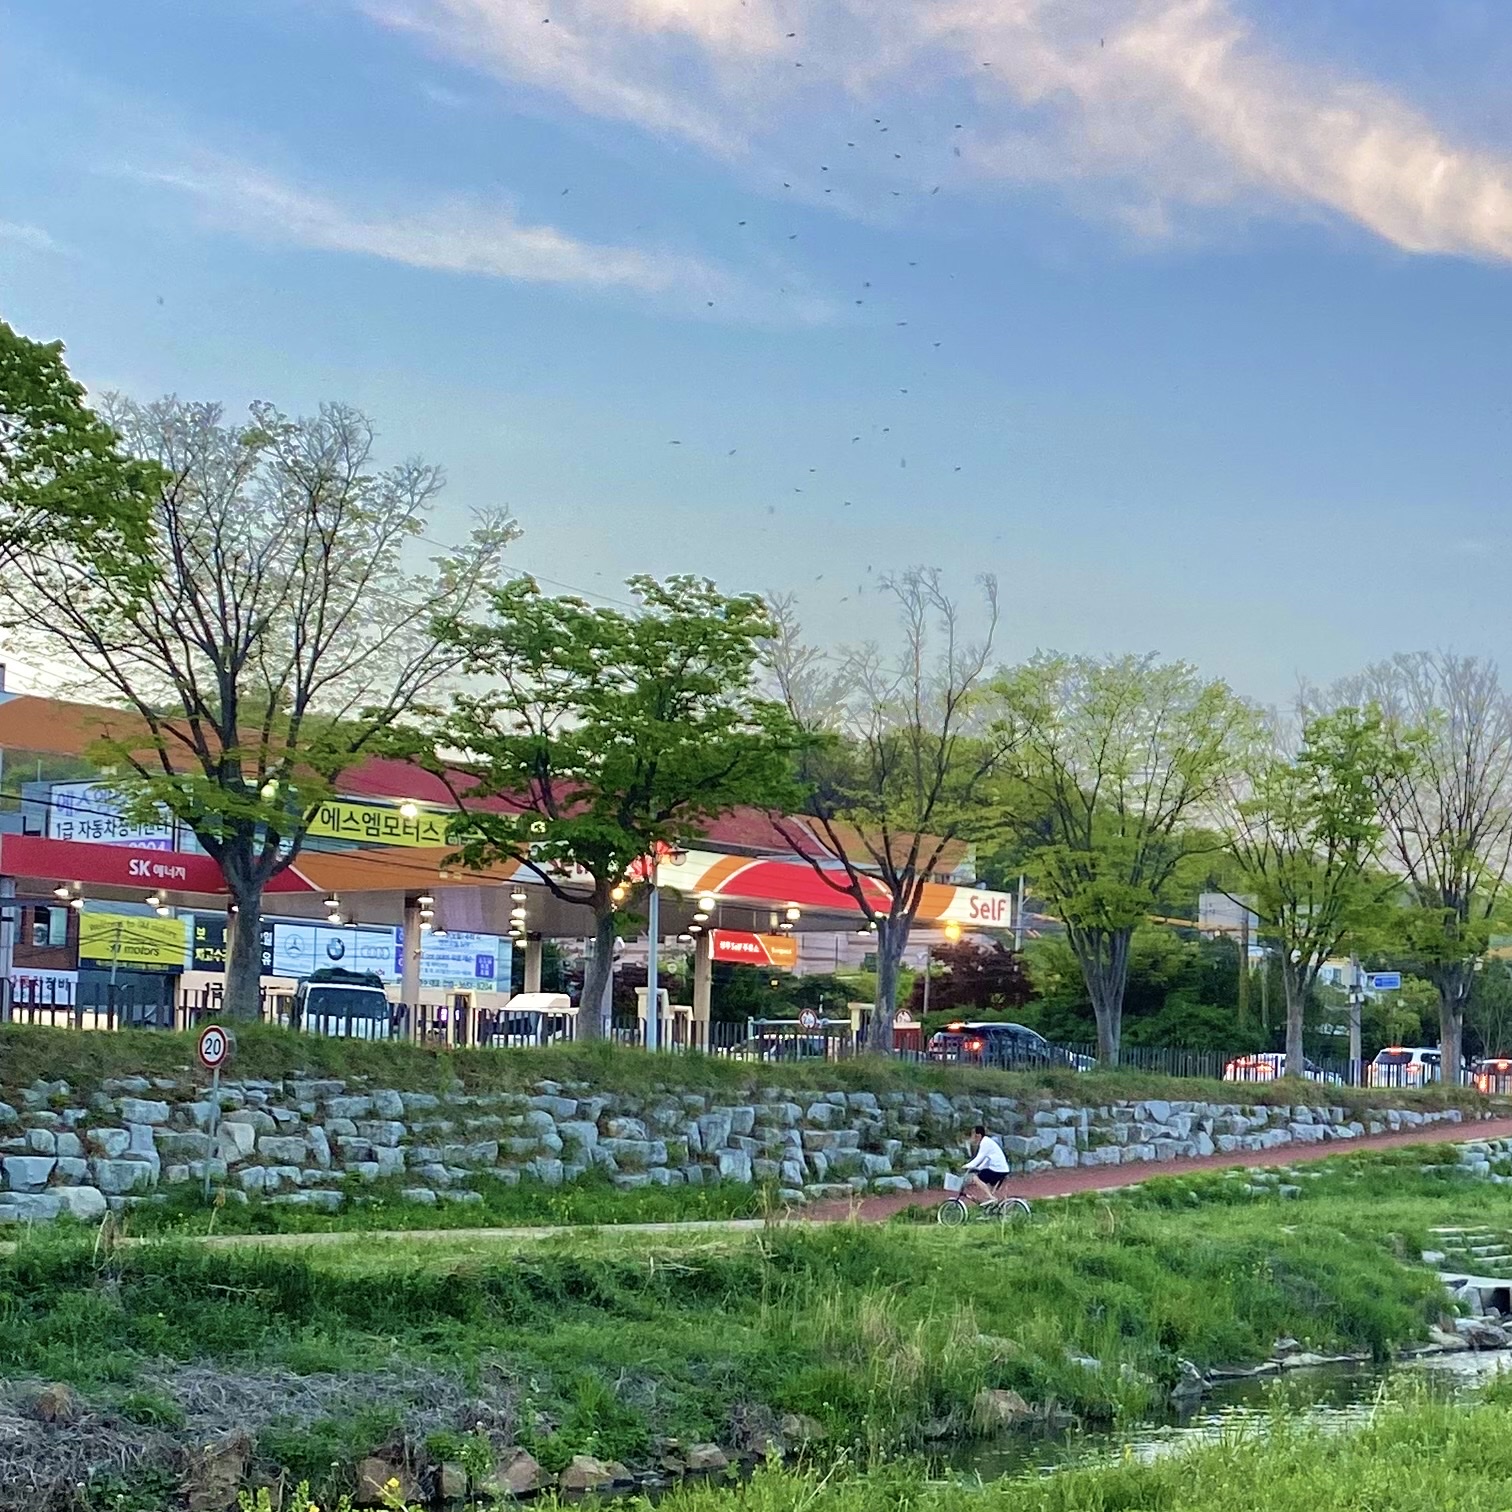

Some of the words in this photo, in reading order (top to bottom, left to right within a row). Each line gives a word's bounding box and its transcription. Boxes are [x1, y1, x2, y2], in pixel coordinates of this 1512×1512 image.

[320, 806, 441, 843] 에스엠모터스
[129, 859, 151, 876] SK
[152, 864, 186, 881] 에너지
[124, 945, 160, 957] motors
[204, 1037, 221, 1056] 20
